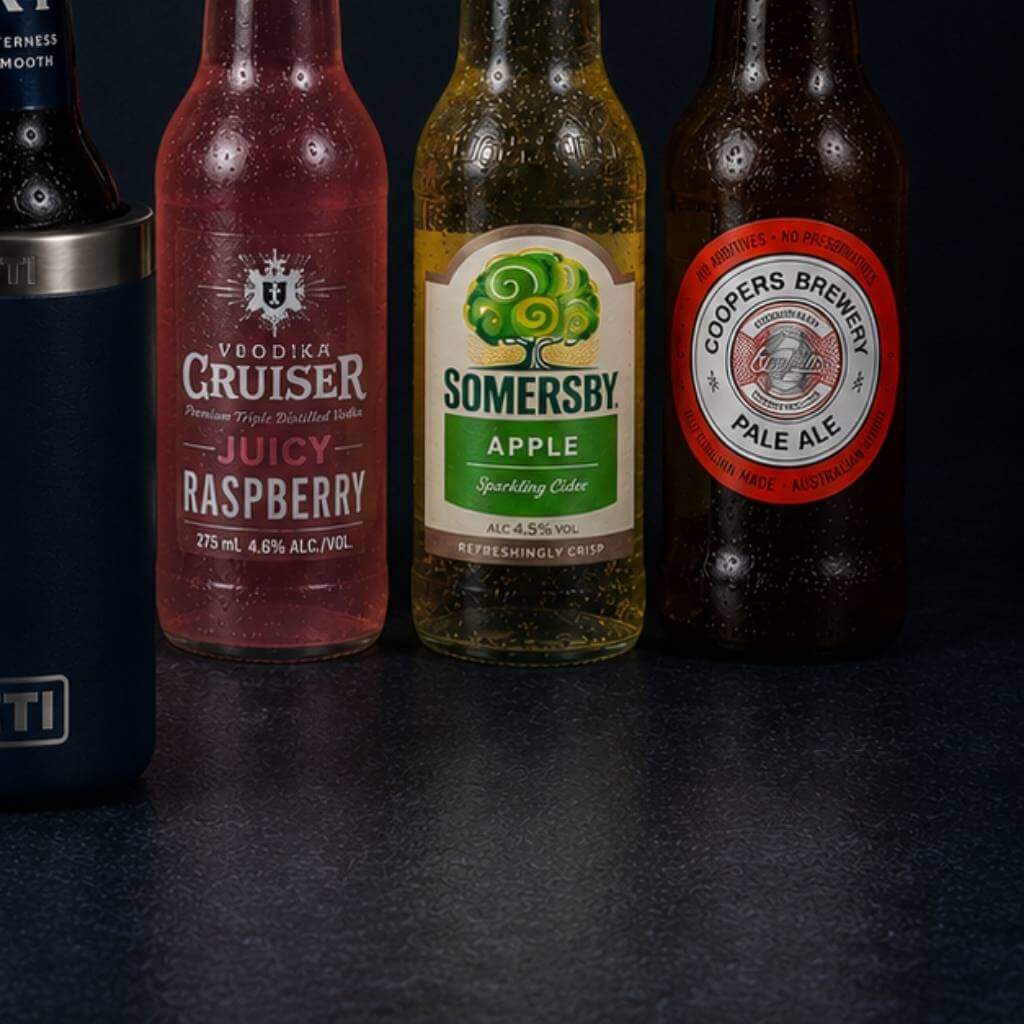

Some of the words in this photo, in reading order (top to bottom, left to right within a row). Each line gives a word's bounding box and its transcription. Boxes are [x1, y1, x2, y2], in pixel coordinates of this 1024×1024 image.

[782, 229, 800, 244] NO
[704, 271, 785, 355] COOPERS
[794, 271, 869, 355] BREWERY
[182, 351, 367, 401] CRUISER
[443, 367, 619, 416] SOMERSBY
[730, 413, 790, 451] PALE
[798, 414, 842, 450] ALE
[217, 434, 332, 466] JUICY
[487, 436, 579, 457] APPLE
[183, 469, 366, 520] RASPBERRY
[475, 475, 547, 499] Sparkling
[549, 477, 590, 495] Cider
[486, 522, 511, 535] ALC
[512, 521, 553, 536] 4.5%
[554, 523, 580, 535] VOL
[196, 532, 219, 550] 275
[221, 536, 242, 553] mL
[248, 537, 286, 555] 4.6%
[458, 541, 564, 559] REFRESHINGLY
[567, 543, 606, 558] CRISP
